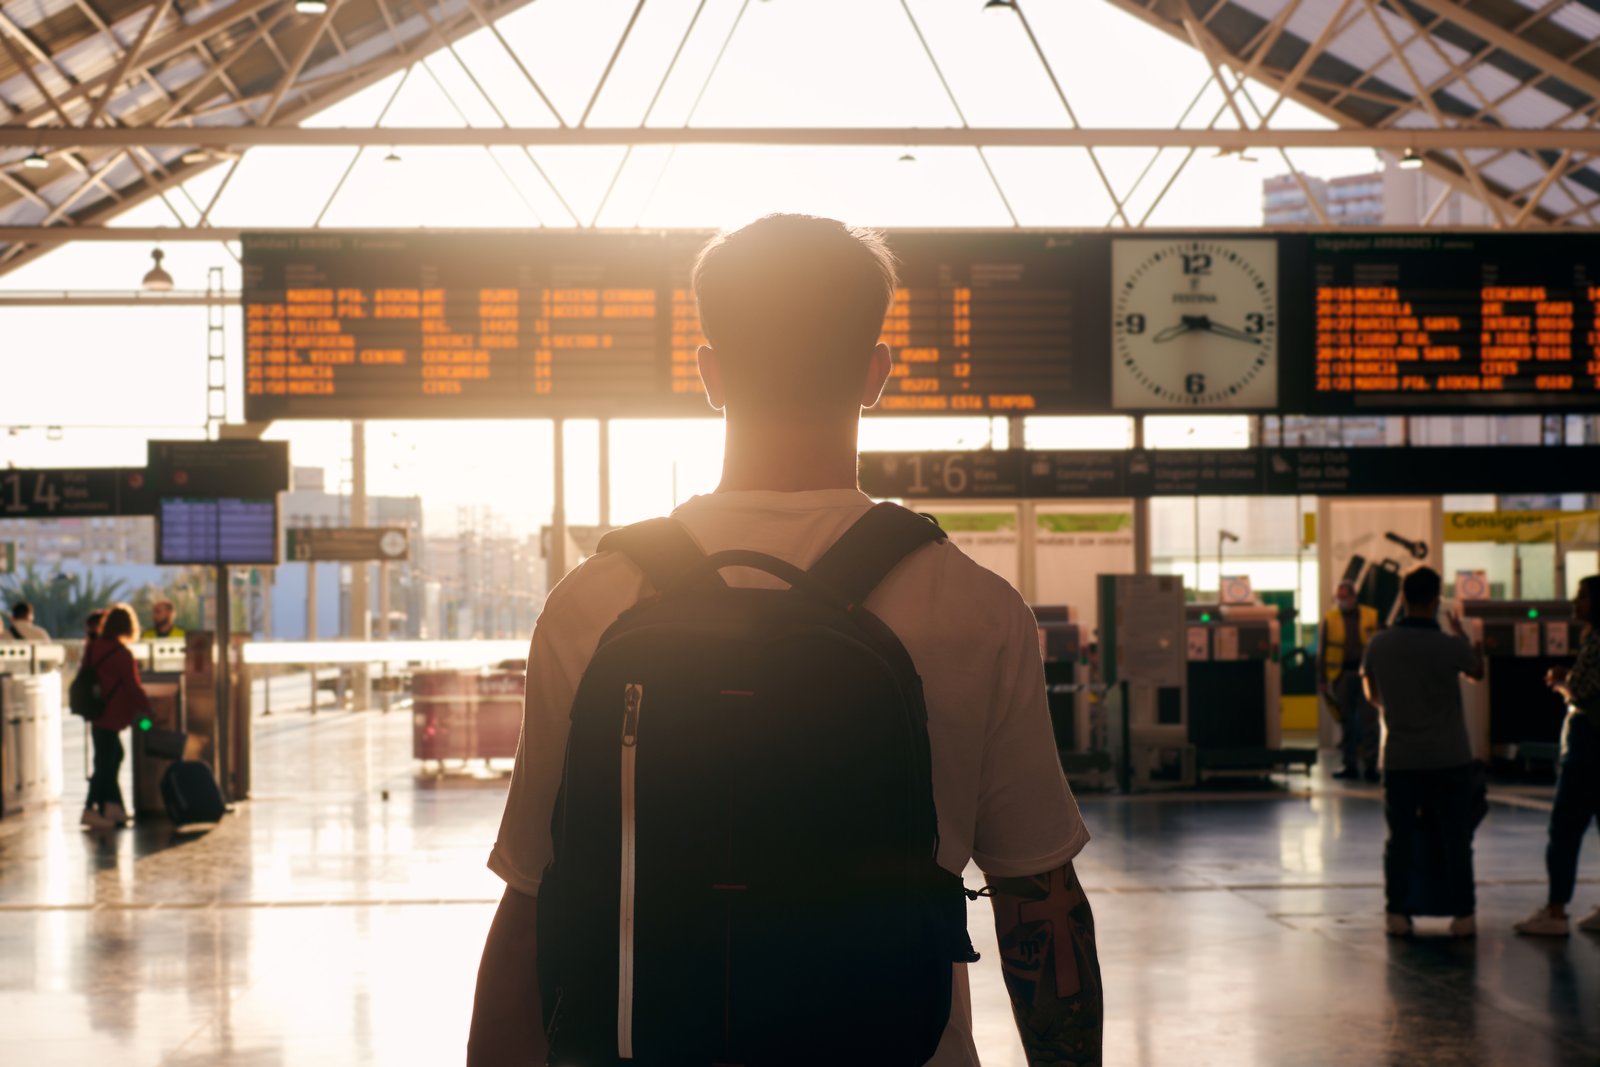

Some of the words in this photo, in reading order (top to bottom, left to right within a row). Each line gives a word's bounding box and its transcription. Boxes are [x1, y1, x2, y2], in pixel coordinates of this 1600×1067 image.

[1181, 253, 1213, 275] 12
[1172, 292, 1218, 304] FESTINA
[1127, 314, 1146, 334] 9
[1245, 313, 1265, 334] 3
[1185, 373, 1205, 395] 6
